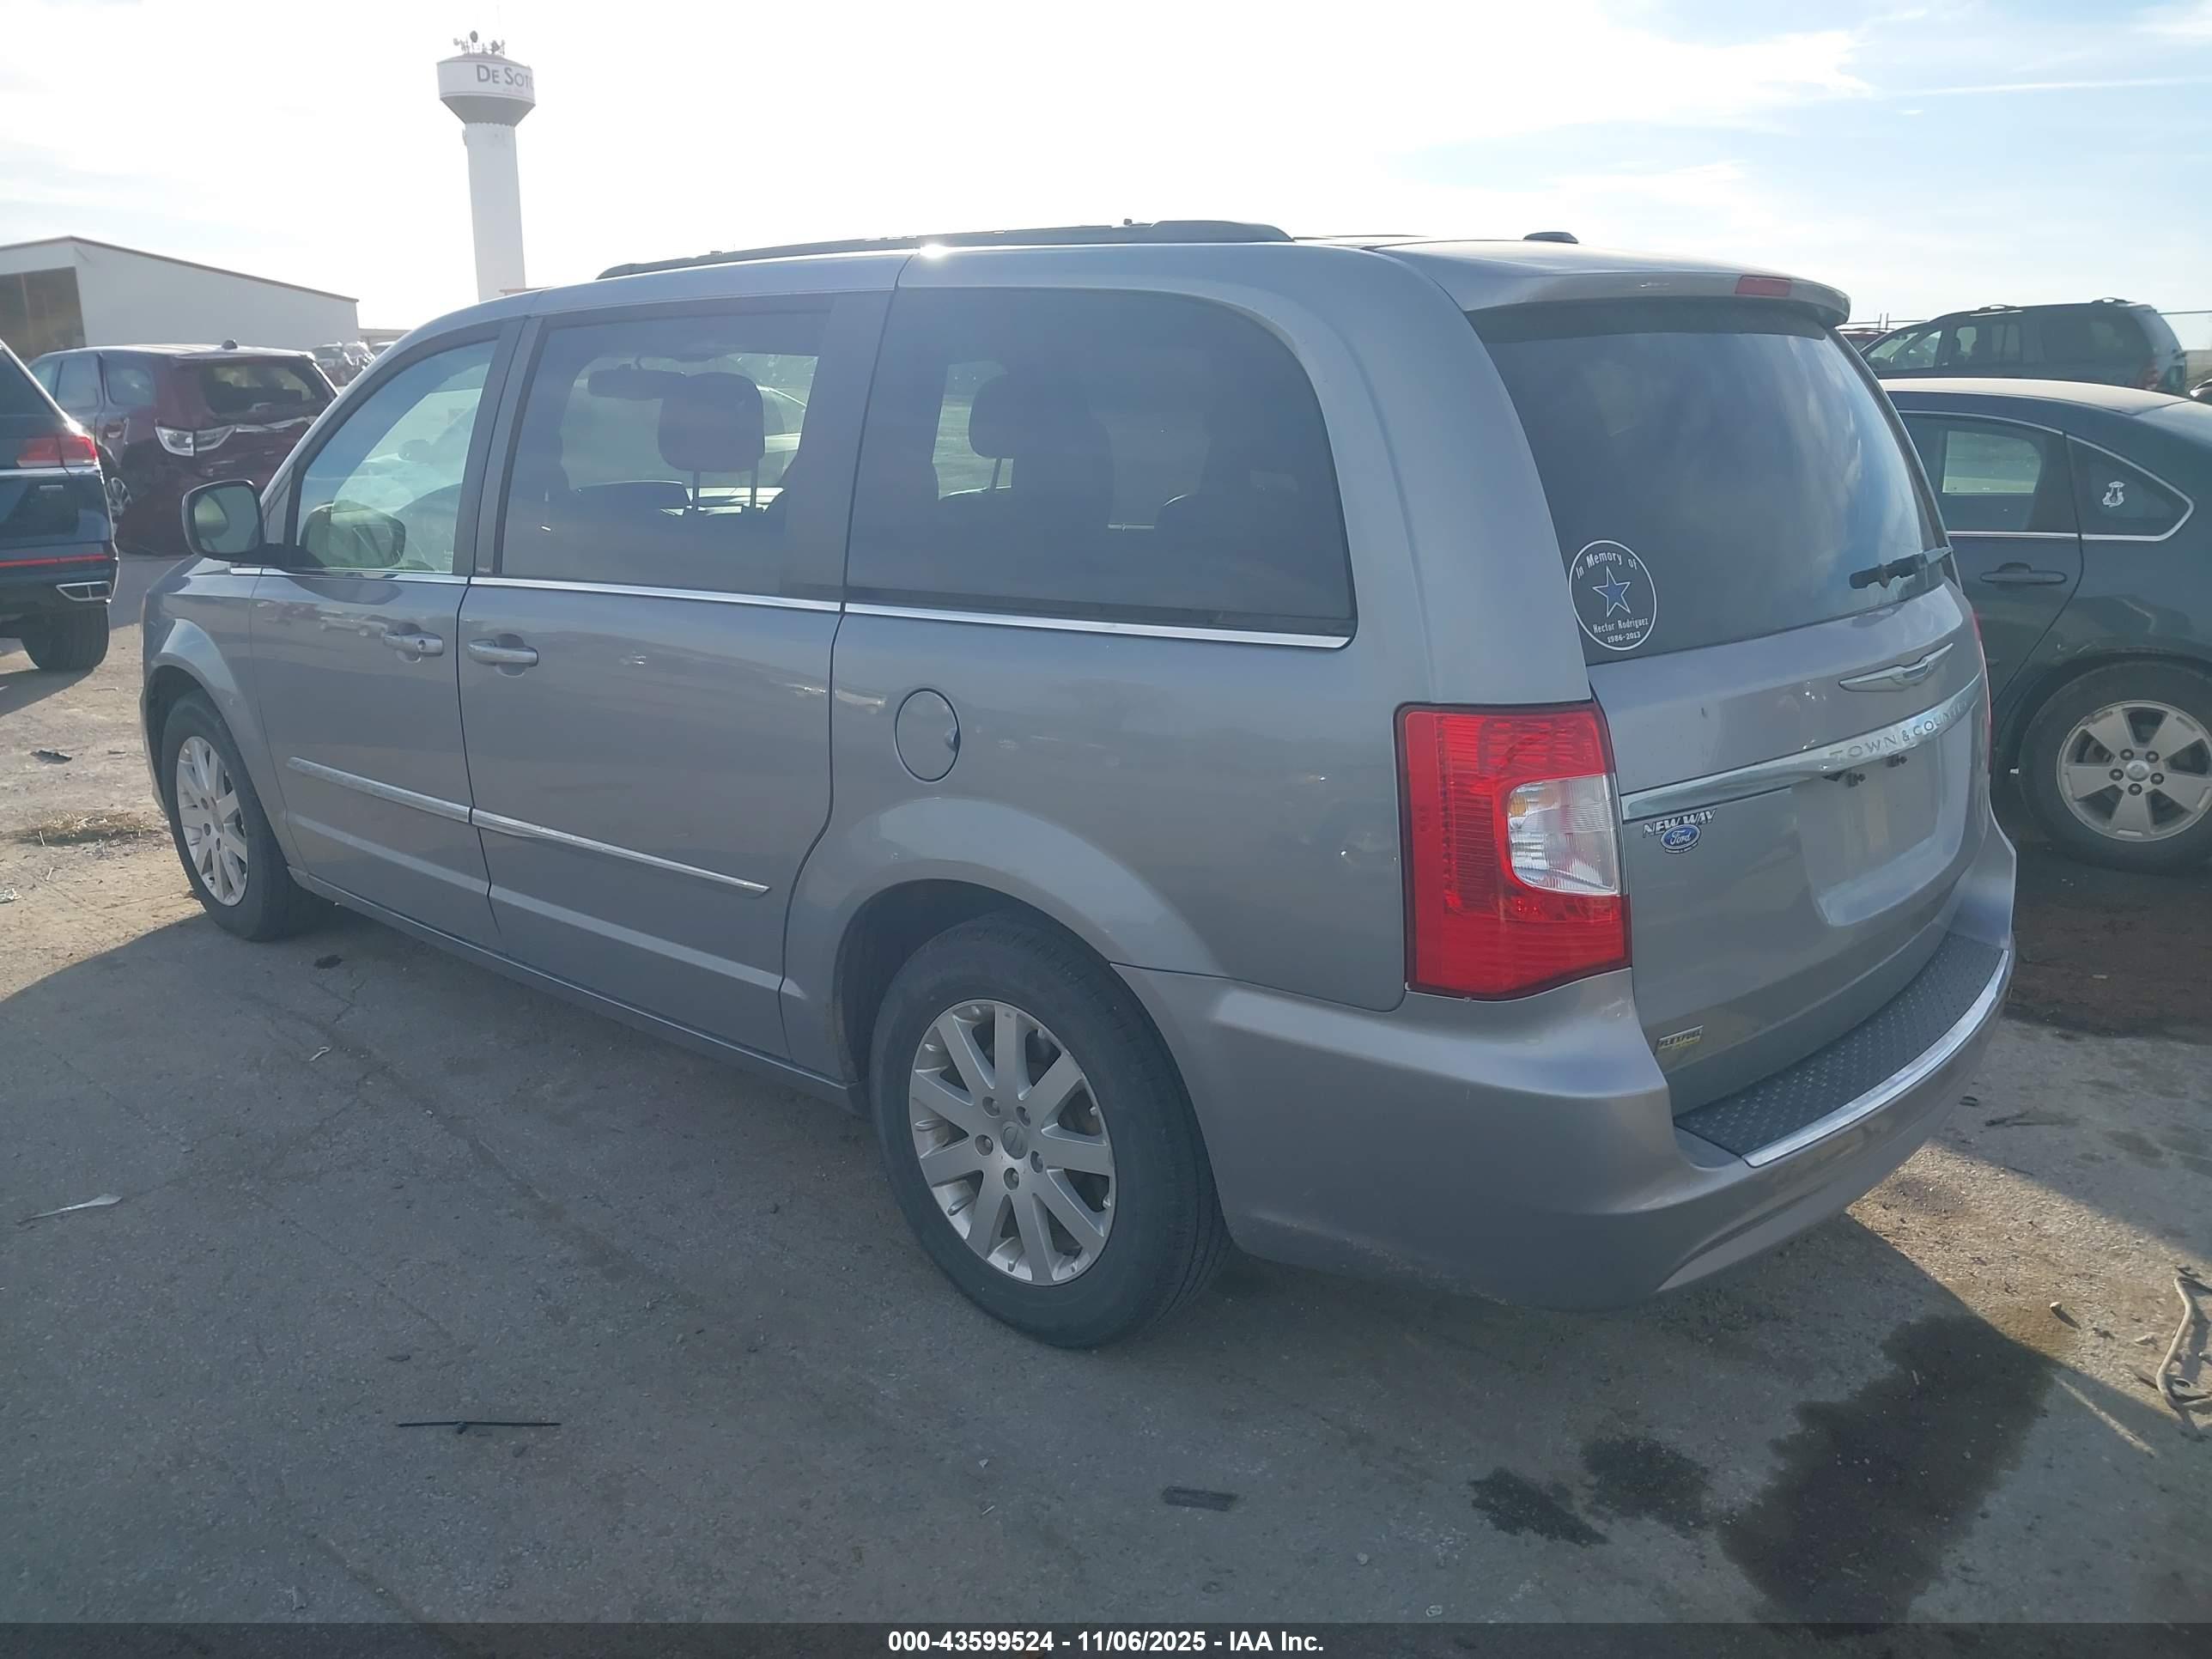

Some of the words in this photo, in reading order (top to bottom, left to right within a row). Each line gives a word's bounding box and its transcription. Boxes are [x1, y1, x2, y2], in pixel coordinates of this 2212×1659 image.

[1576, 566, 1584, 580] In
[1586, 551, 1623, 568] Memory
[1593, 623, 1615, 634] Hector
[1617, 617, 1650, 630] Rodriguez
[1607, 631, 1641, 643] 1986-2013
[1829, 734, 1897, 762] TOWN
[1643, 817, 1680, 837] NEW
[1683, 809, 1717, 826] WAY
[1669, 830, 1692, 845] Ford
